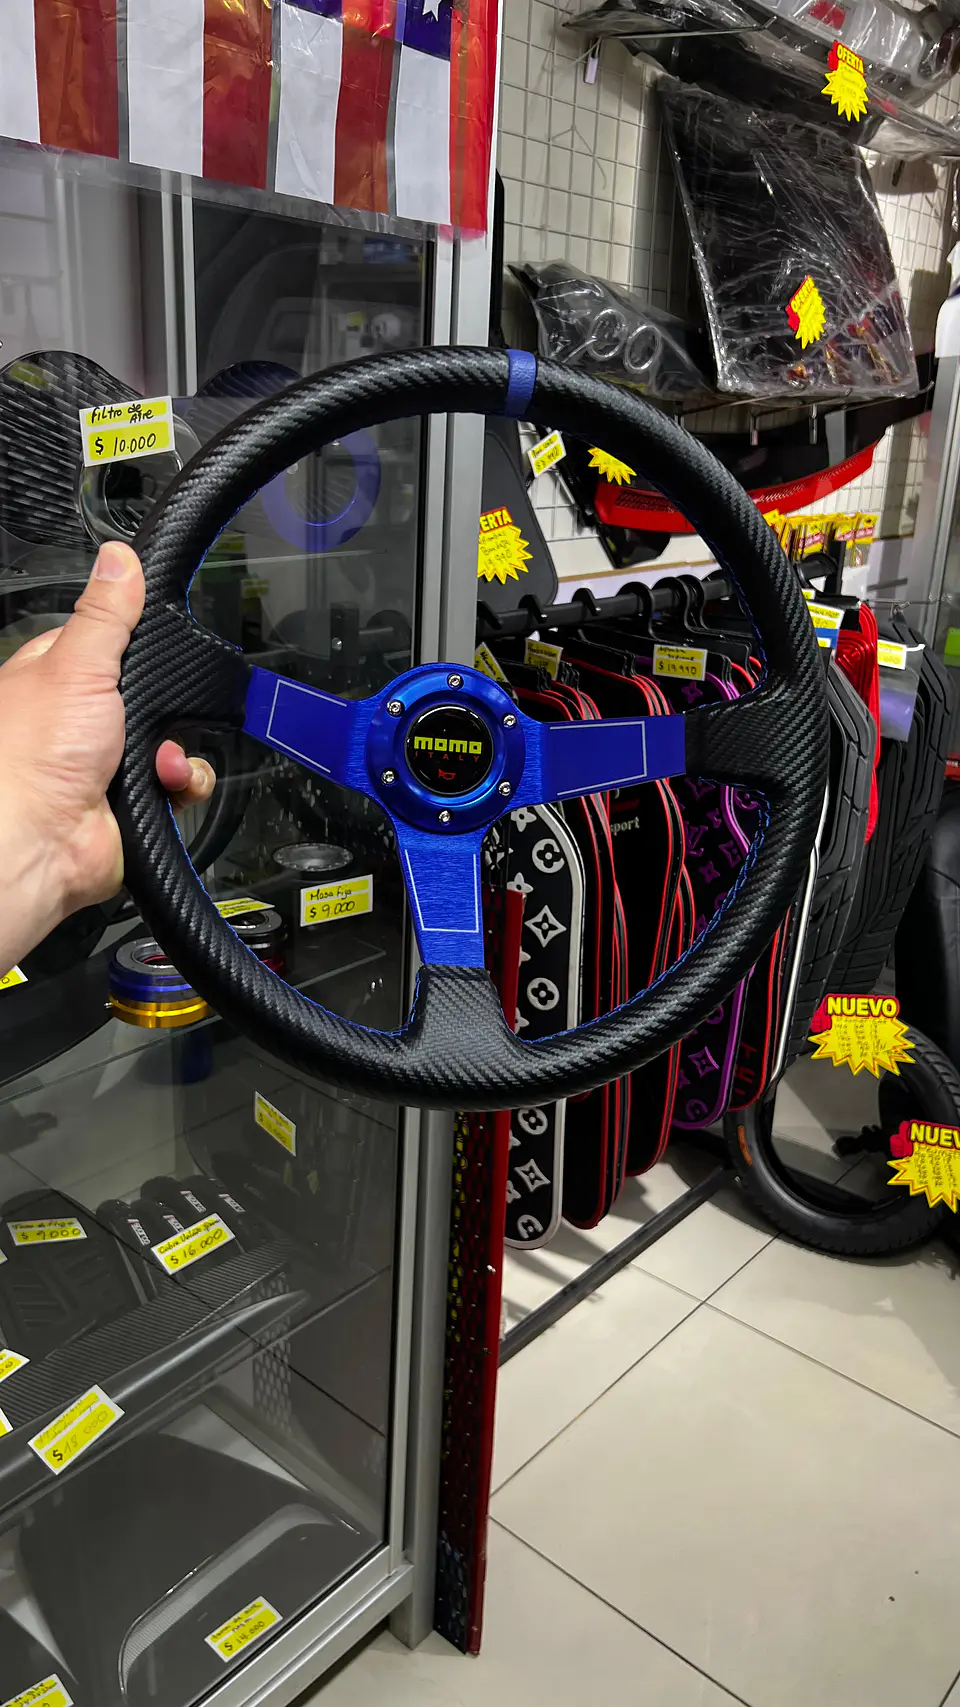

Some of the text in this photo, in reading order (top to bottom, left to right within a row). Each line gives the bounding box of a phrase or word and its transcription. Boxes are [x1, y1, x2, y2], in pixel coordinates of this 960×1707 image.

[836, 44, 865, 75] OFERTA
[790, 276, 814, 313] OFERTA
[94, 433, 157, 456] $ 10.000
[479, 509, 513, 532] ERTA
[658, 661, 664, 670] $
[414, 751, 480, 762] ITALY
[309, 906, 317, 918] $
[827, 997, 897, 1017] NUEVO
[21, 1231, 29, 1240] $
[170, 1255, 179, 1265] $
[52, 1449, 64, 1462] $
[224, 1641, 233, 1652] $
